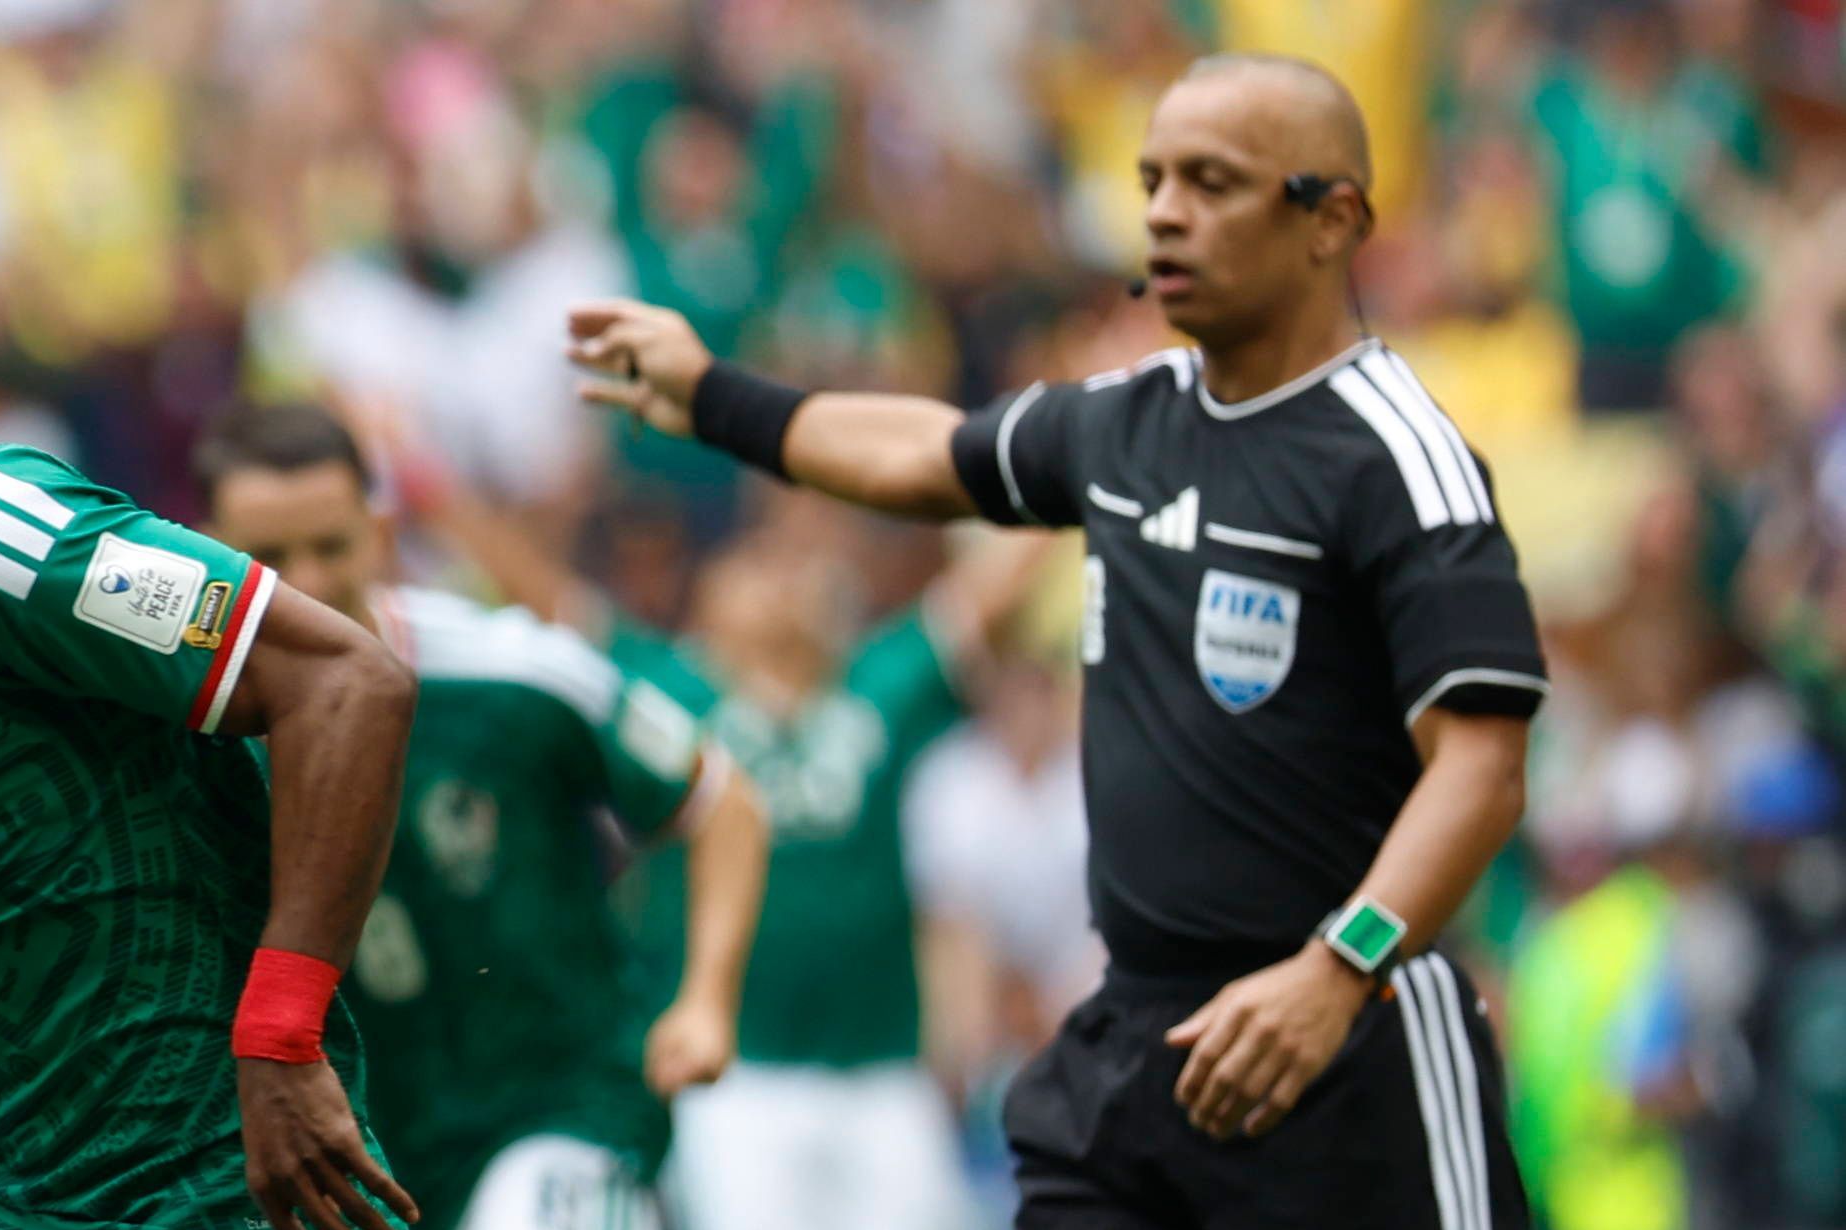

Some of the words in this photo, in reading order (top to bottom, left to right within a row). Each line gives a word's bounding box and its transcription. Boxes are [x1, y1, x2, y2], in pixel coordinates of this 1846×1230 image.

[146, 575, 176, 621] PEACE
[168, 594, 184, 618] FIFA
[1210, 586, 1286, 625] FIFA
